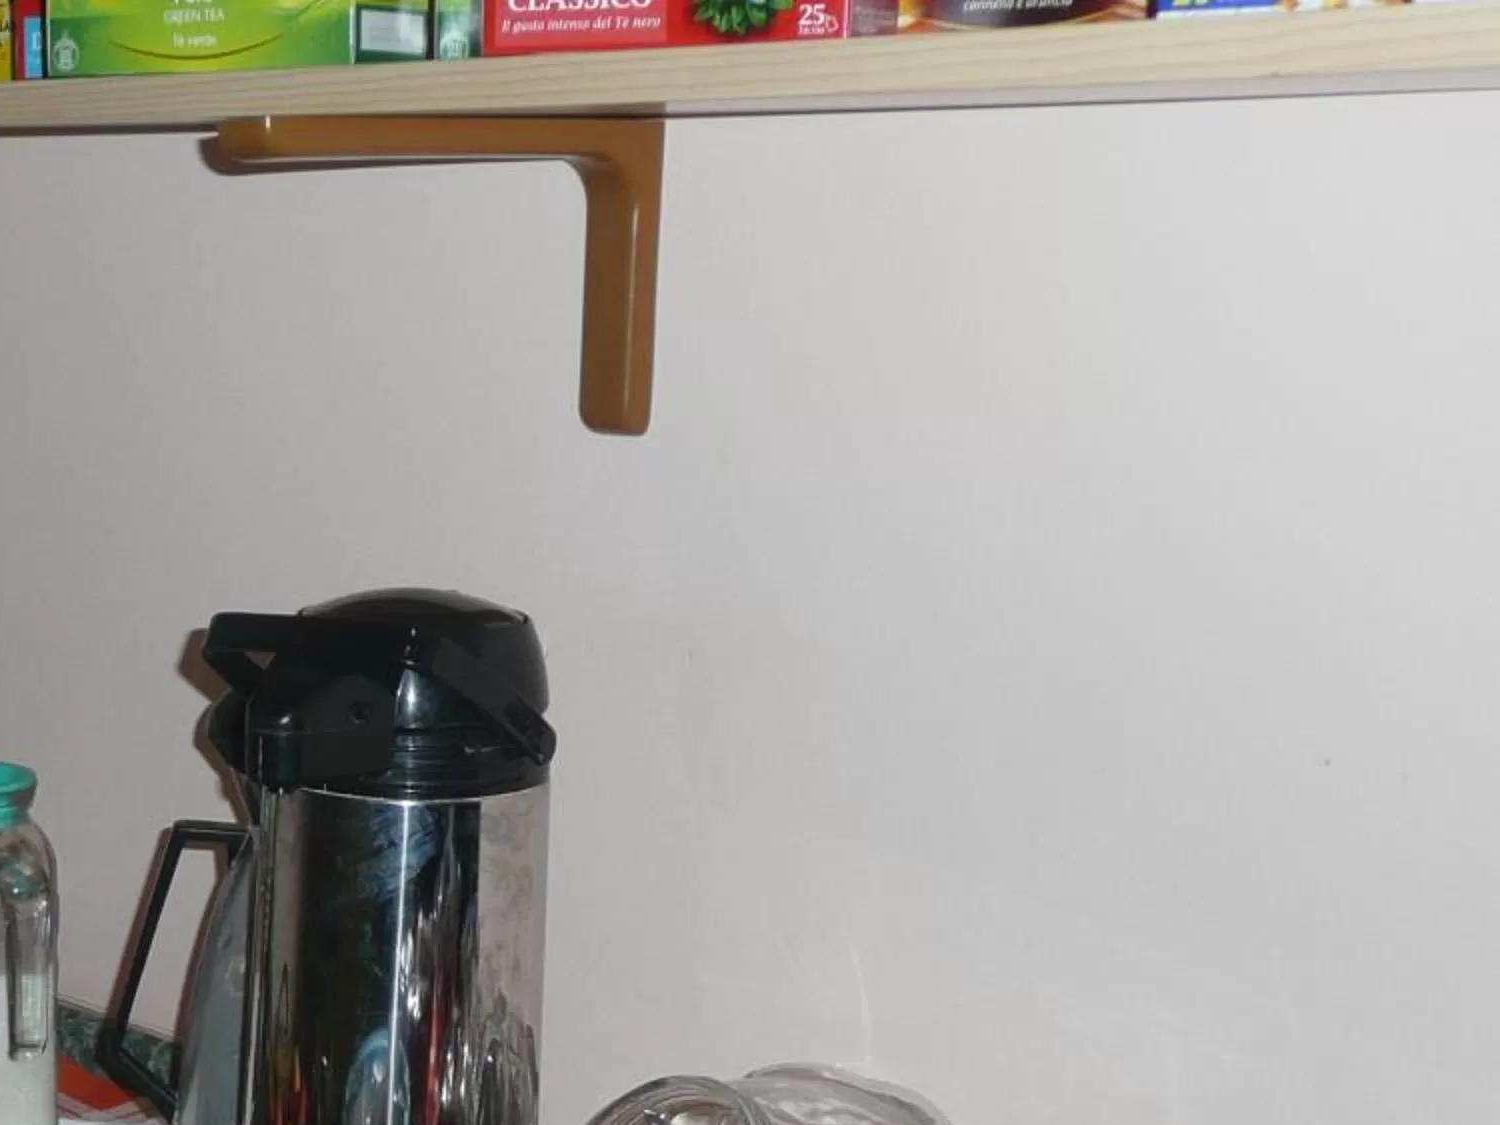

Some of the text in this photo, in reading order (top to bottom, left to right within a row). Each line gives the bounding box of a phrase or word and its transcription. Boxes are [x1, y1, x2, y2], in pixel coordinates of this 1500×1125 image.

[203, 8, 225, 22] TEA
[799, 4, 826, 25] 25
[512, 19, 545, 34] gusto
[547, 17, 590, 32] intenso
[592, 15, 611, 30] del
[632, 16, 661, 29] nero
